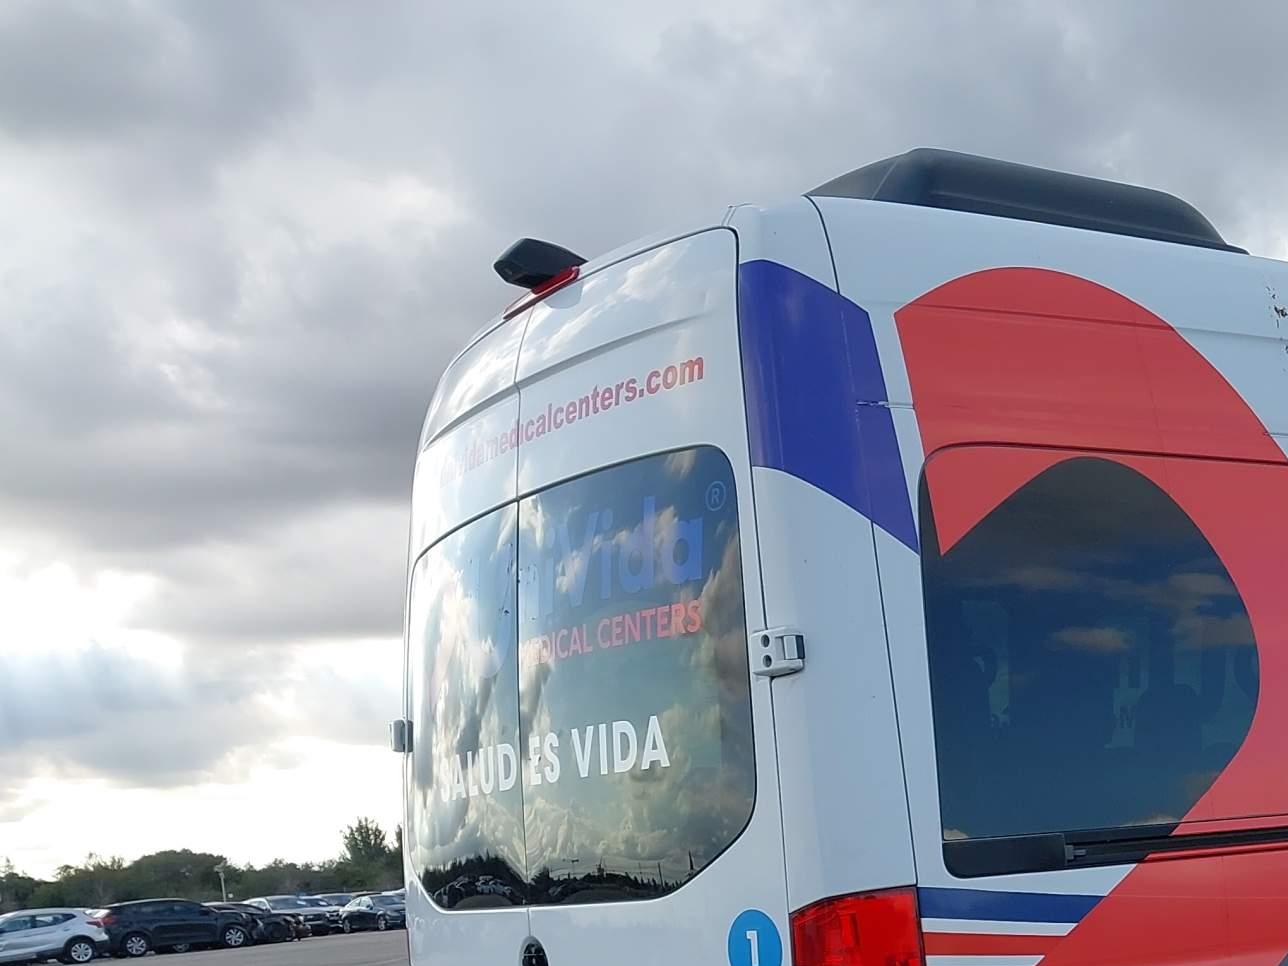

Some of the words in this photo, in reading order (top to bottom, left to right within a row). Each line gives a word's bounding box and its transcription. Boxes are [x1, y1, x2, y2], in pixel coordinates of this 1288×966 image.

[598, 600, 703, 649] CENTERS
[439, 743, 518, 801] SALUD
[528, 732, 560, 786] ES
[571, 715, 670, 778] VIDA
